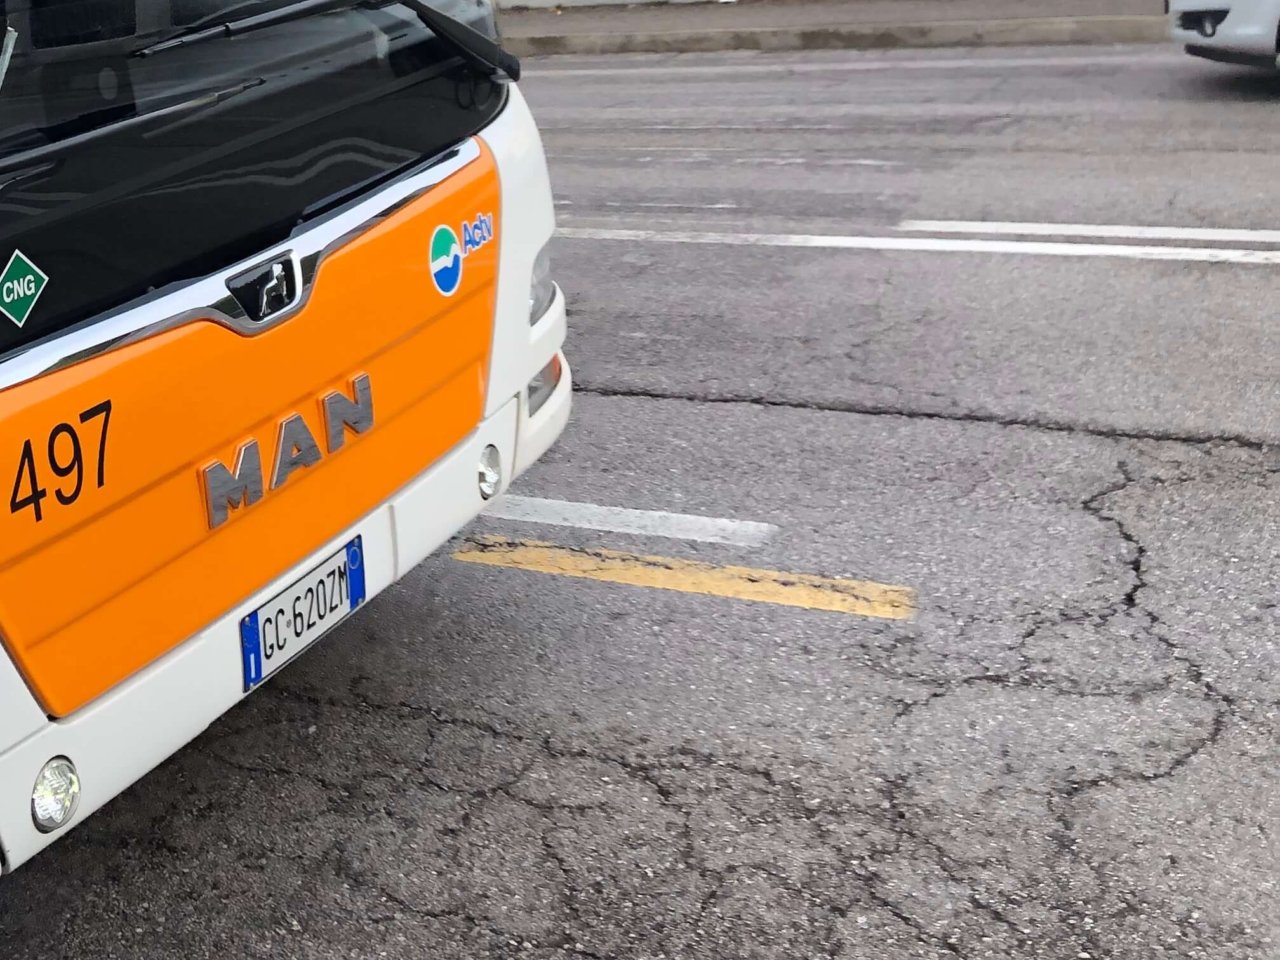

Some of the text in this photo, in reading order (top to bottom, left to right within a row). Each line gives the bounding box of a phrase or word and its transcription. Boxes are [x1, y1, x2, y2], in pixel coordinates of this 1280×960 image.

[2, 274, 36, 303] CNG
[10, 399, 112, 522] 497
[198, 371, 374, 530] MAN
